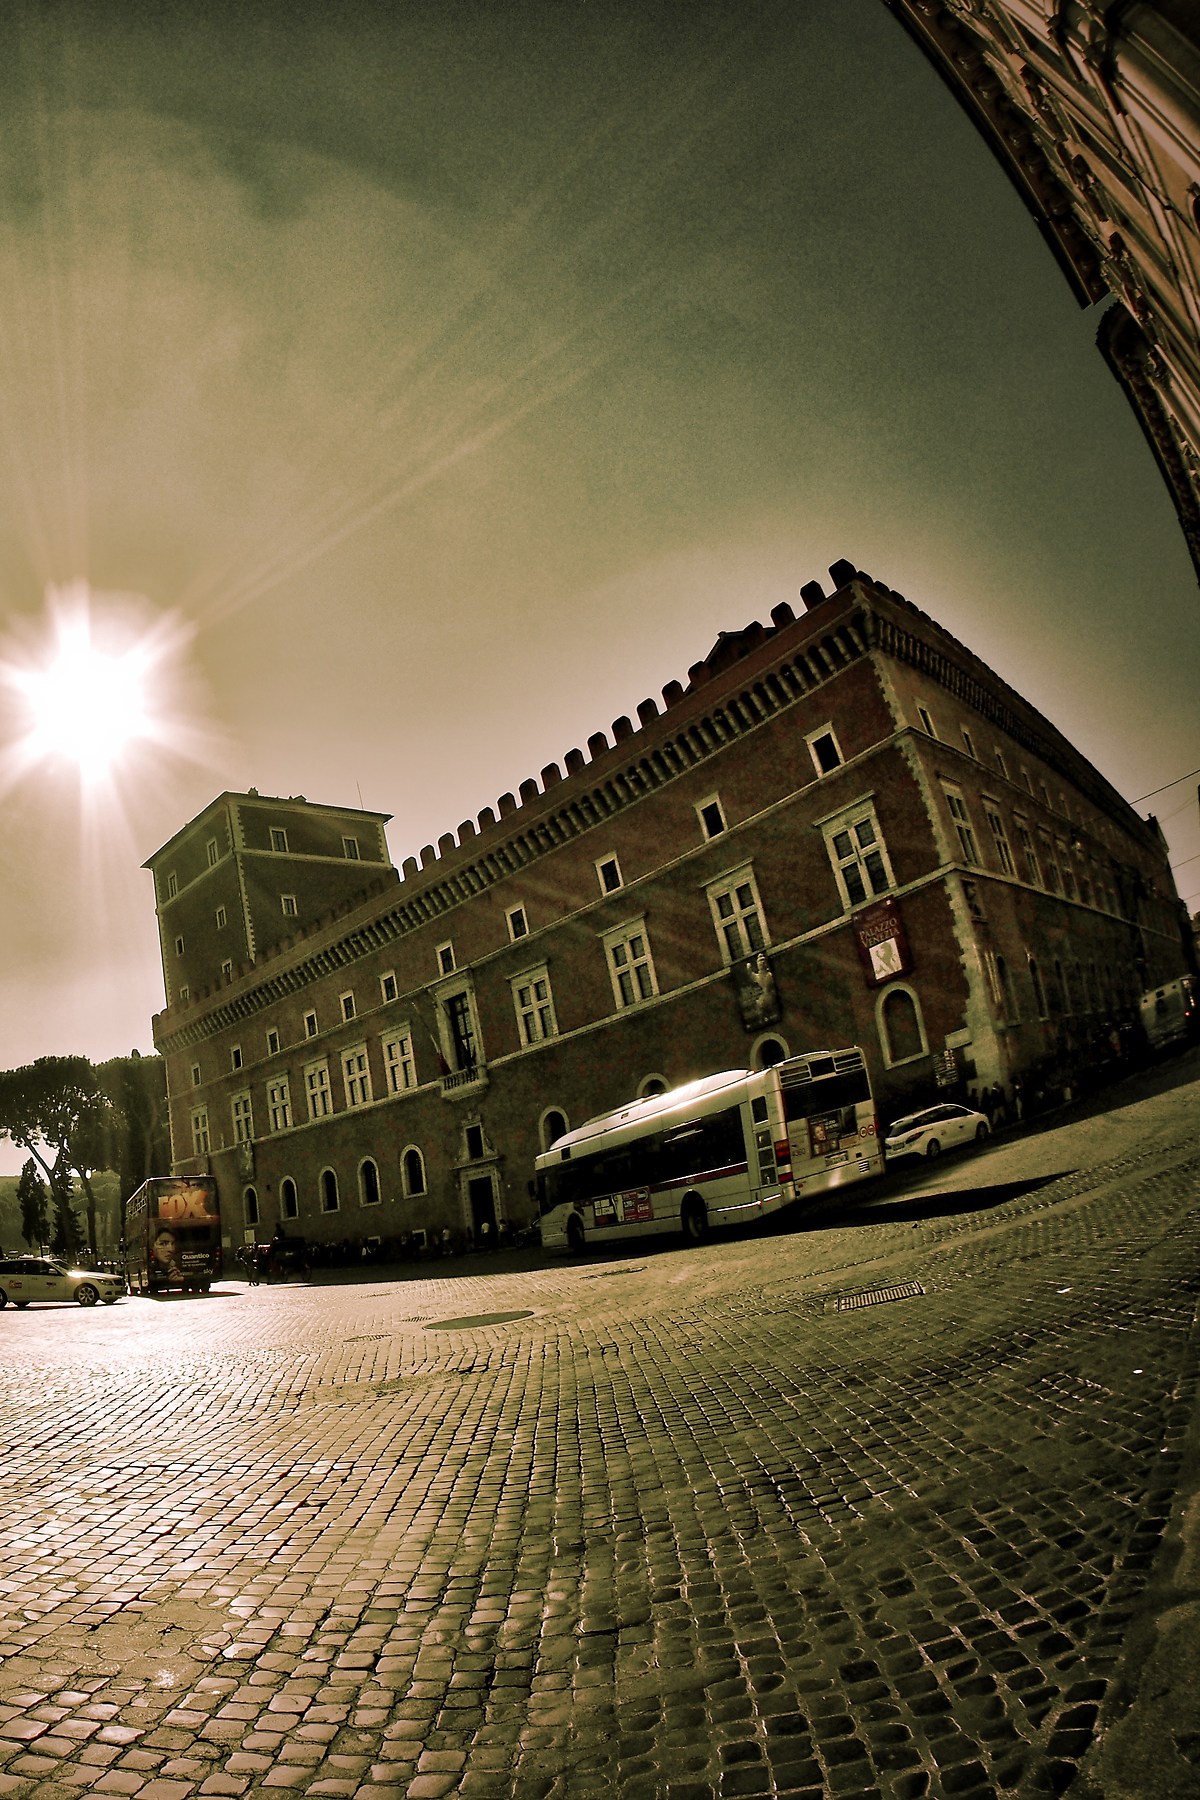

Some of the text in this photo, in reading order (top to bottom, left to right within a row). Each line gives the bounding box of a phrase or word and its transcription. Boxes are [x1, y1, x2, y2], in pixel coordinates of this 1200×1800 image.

[859, 917, 897, 938] PALAZZO
[861, 928, 900, 948] VENEZIA
[158, 1190, 209, 1218] FOX
